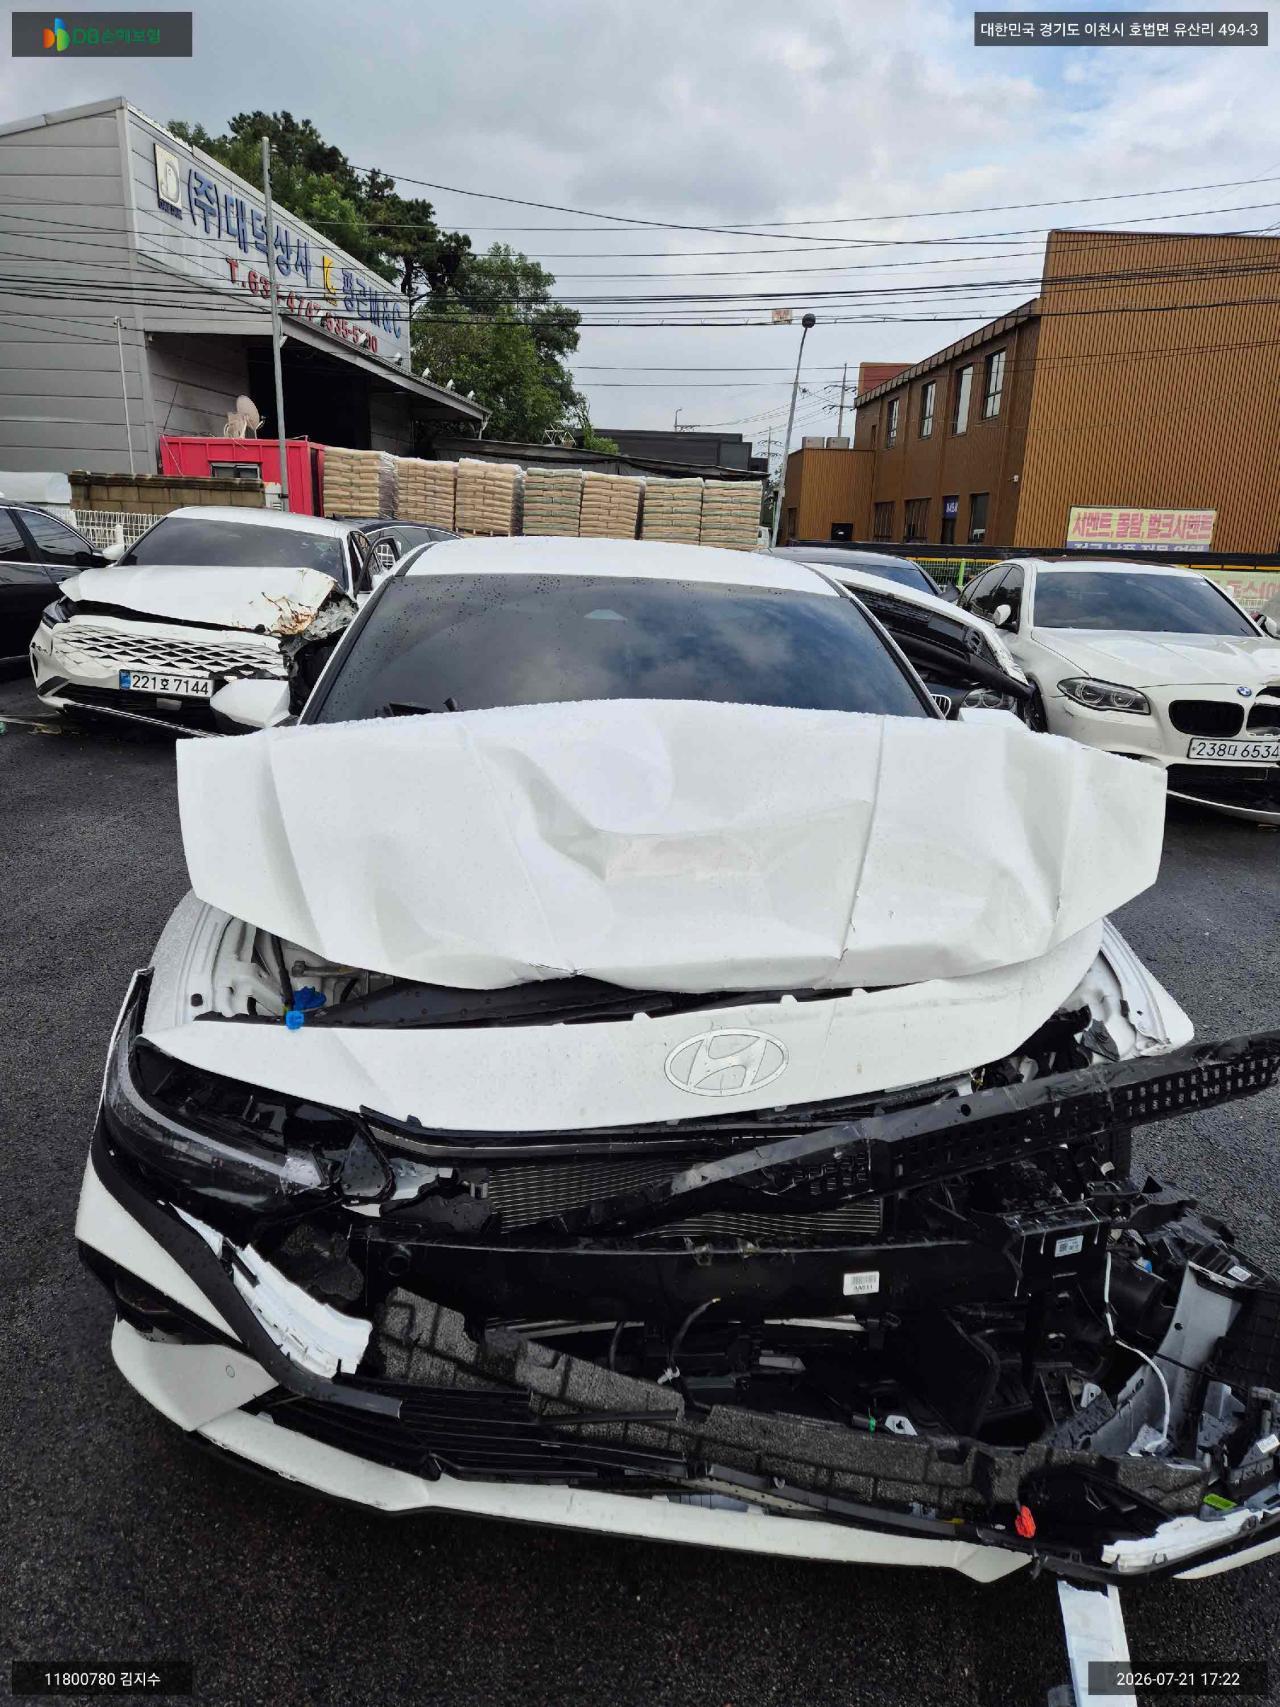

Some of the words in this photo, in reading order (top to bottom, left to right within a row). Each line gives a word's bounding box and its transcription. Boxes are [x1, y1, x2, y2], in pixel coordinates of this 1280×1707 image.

[132, 674, 170, 691] 221호
[173, 678, 209, 695] 7144
[1240, 744, 1280, 759] 6534
